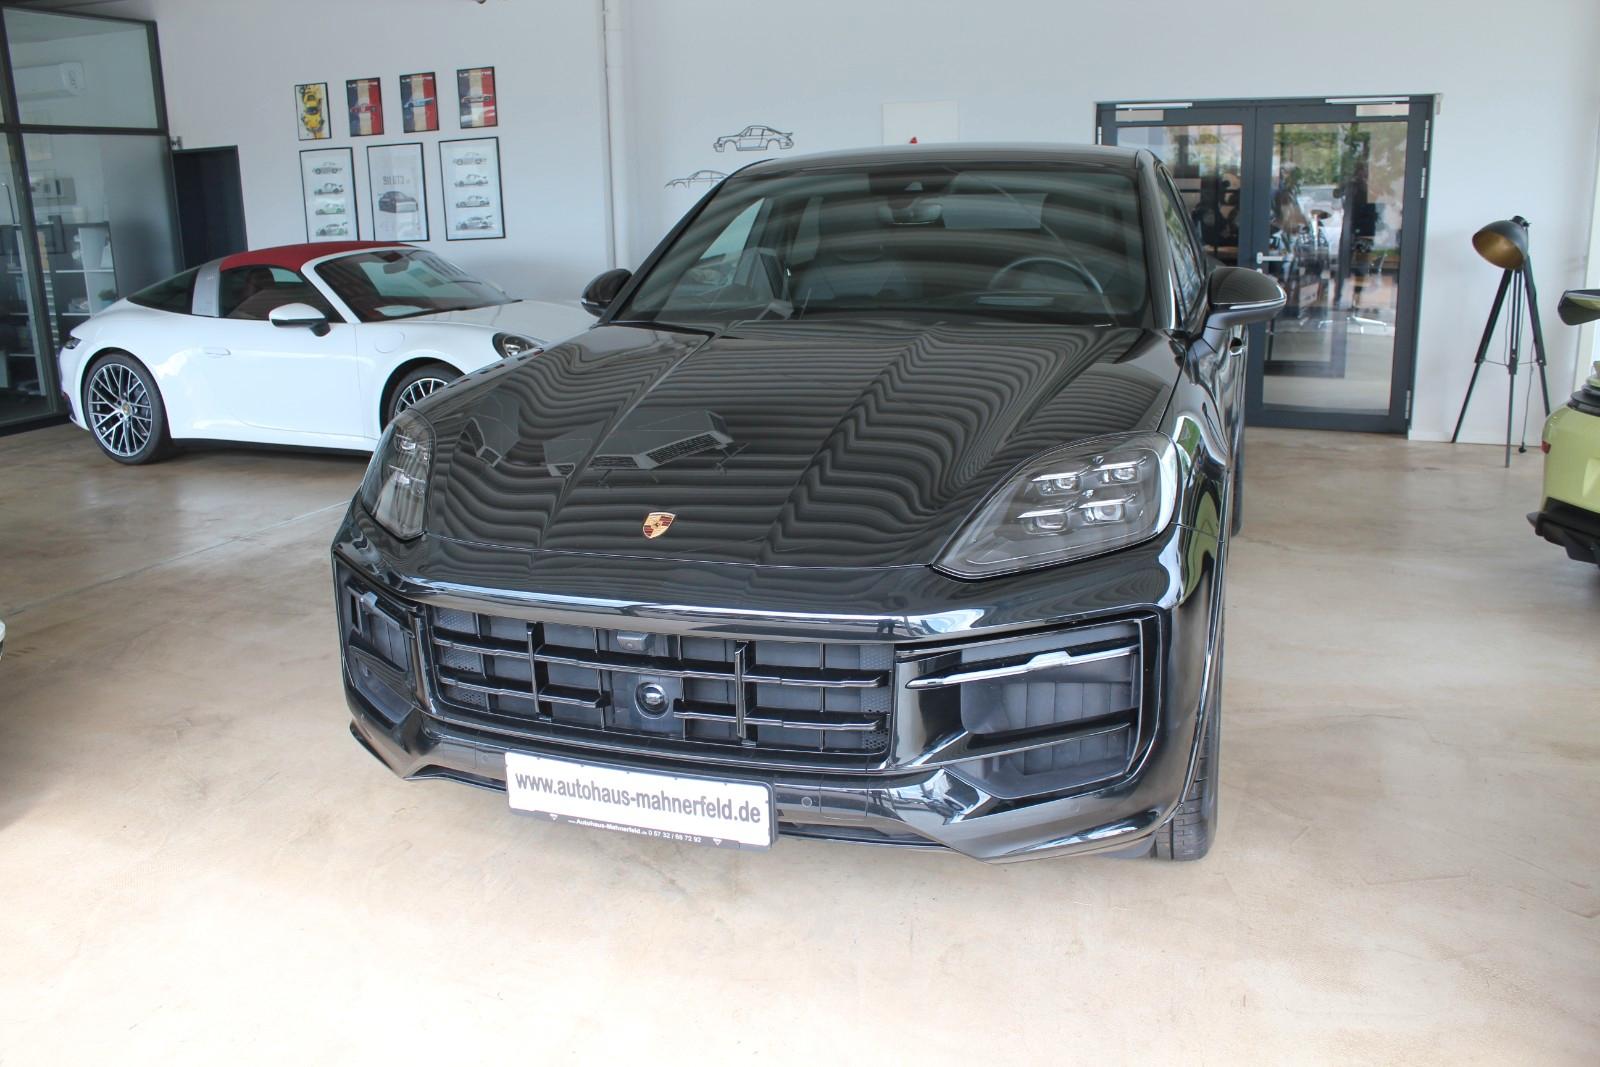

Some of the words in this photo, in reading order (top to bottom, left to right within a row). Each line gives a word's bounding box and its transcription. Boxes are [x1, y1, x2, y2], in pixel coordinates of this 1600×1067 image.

[514, 772, 761, 824] www.autohaus-mahnerfeld.de
[662, 831, 671, 839] 32
[684, 834, 692, 842] 72
